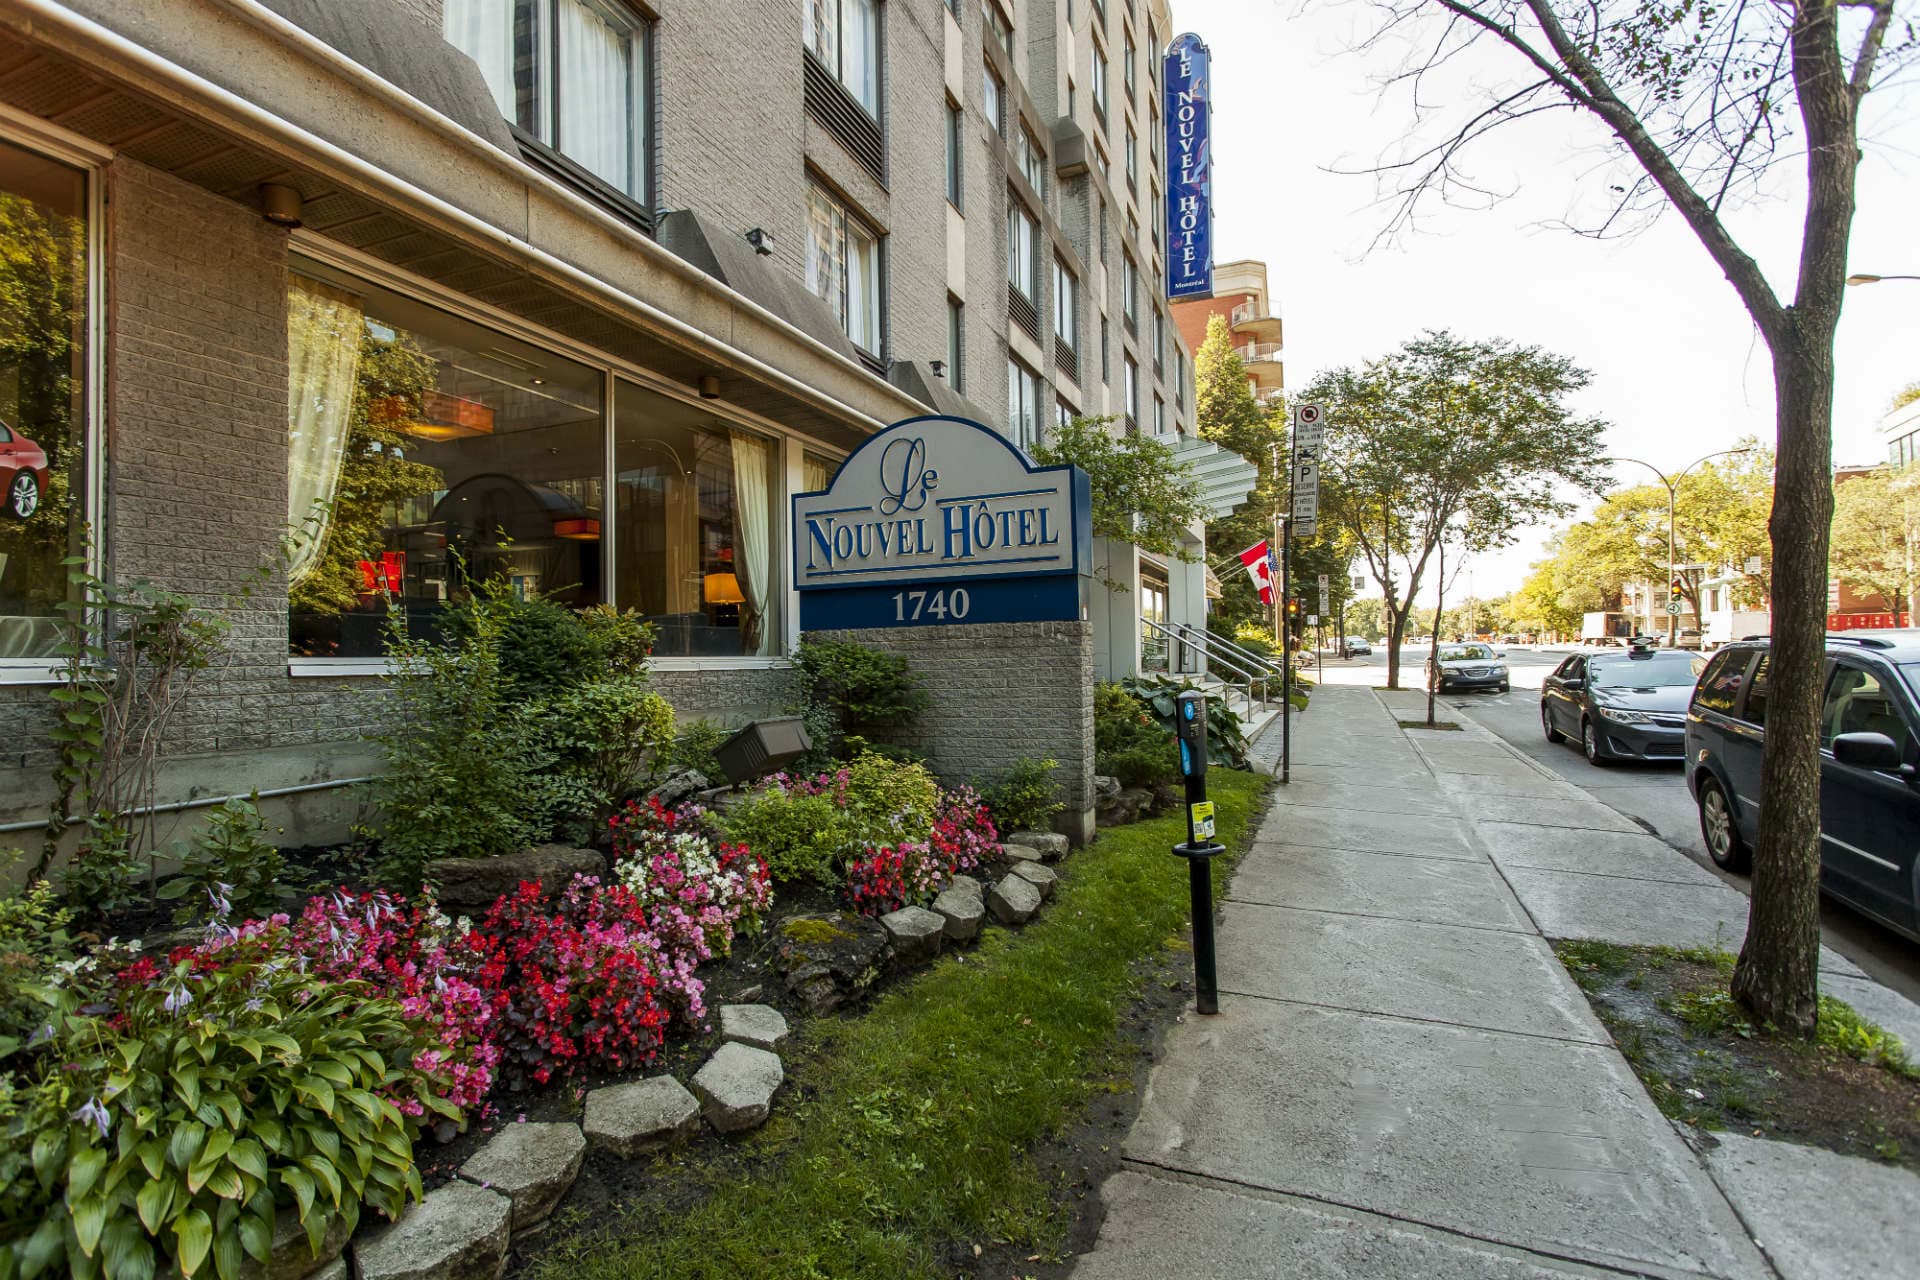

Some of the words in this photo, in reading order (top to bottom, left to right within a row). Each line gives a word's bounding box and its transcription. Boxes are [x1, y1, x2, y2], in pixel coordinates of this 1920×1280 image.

[1179, 47, 1193, 78] LE
[1178, 89, 1196, 185] NOUVEL
[1179, 196, 1196, 278] HÔTEL
[879, 437, 939, 516] Le
[1301, 467, 1311, 482] P
[805, 517, 935, 570] NOUVEL
[940, 501, 1060, 560] HÔTEL
[892, 588, 970, 621] 1740
